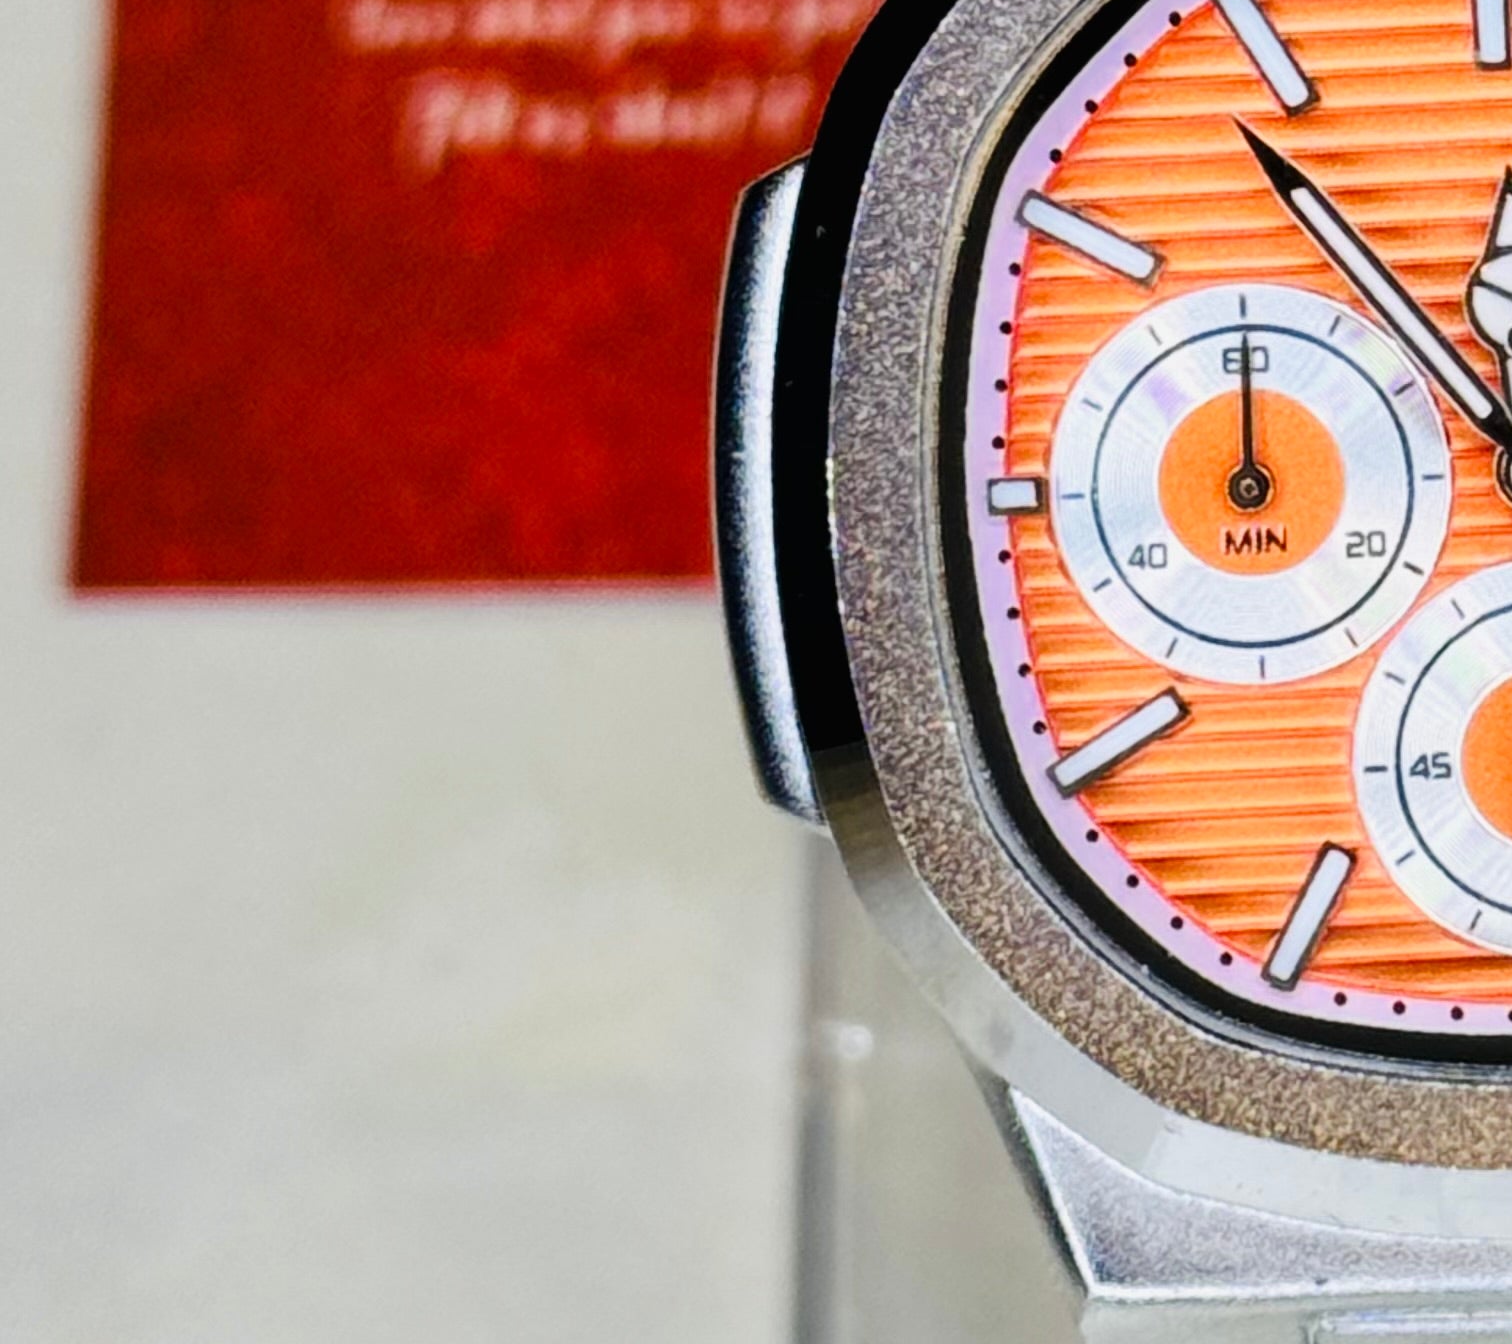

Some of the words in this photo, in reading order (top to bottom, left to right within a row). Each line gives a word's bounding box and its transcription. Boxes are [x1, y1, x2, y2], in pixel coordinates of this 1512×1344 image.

[1224, 527, 1288, 555] MIN
[1345, 530, 1387, 558] 20
[1127, 543, 1168, 569] 40
[1408, 752, 1452, 779] 45
